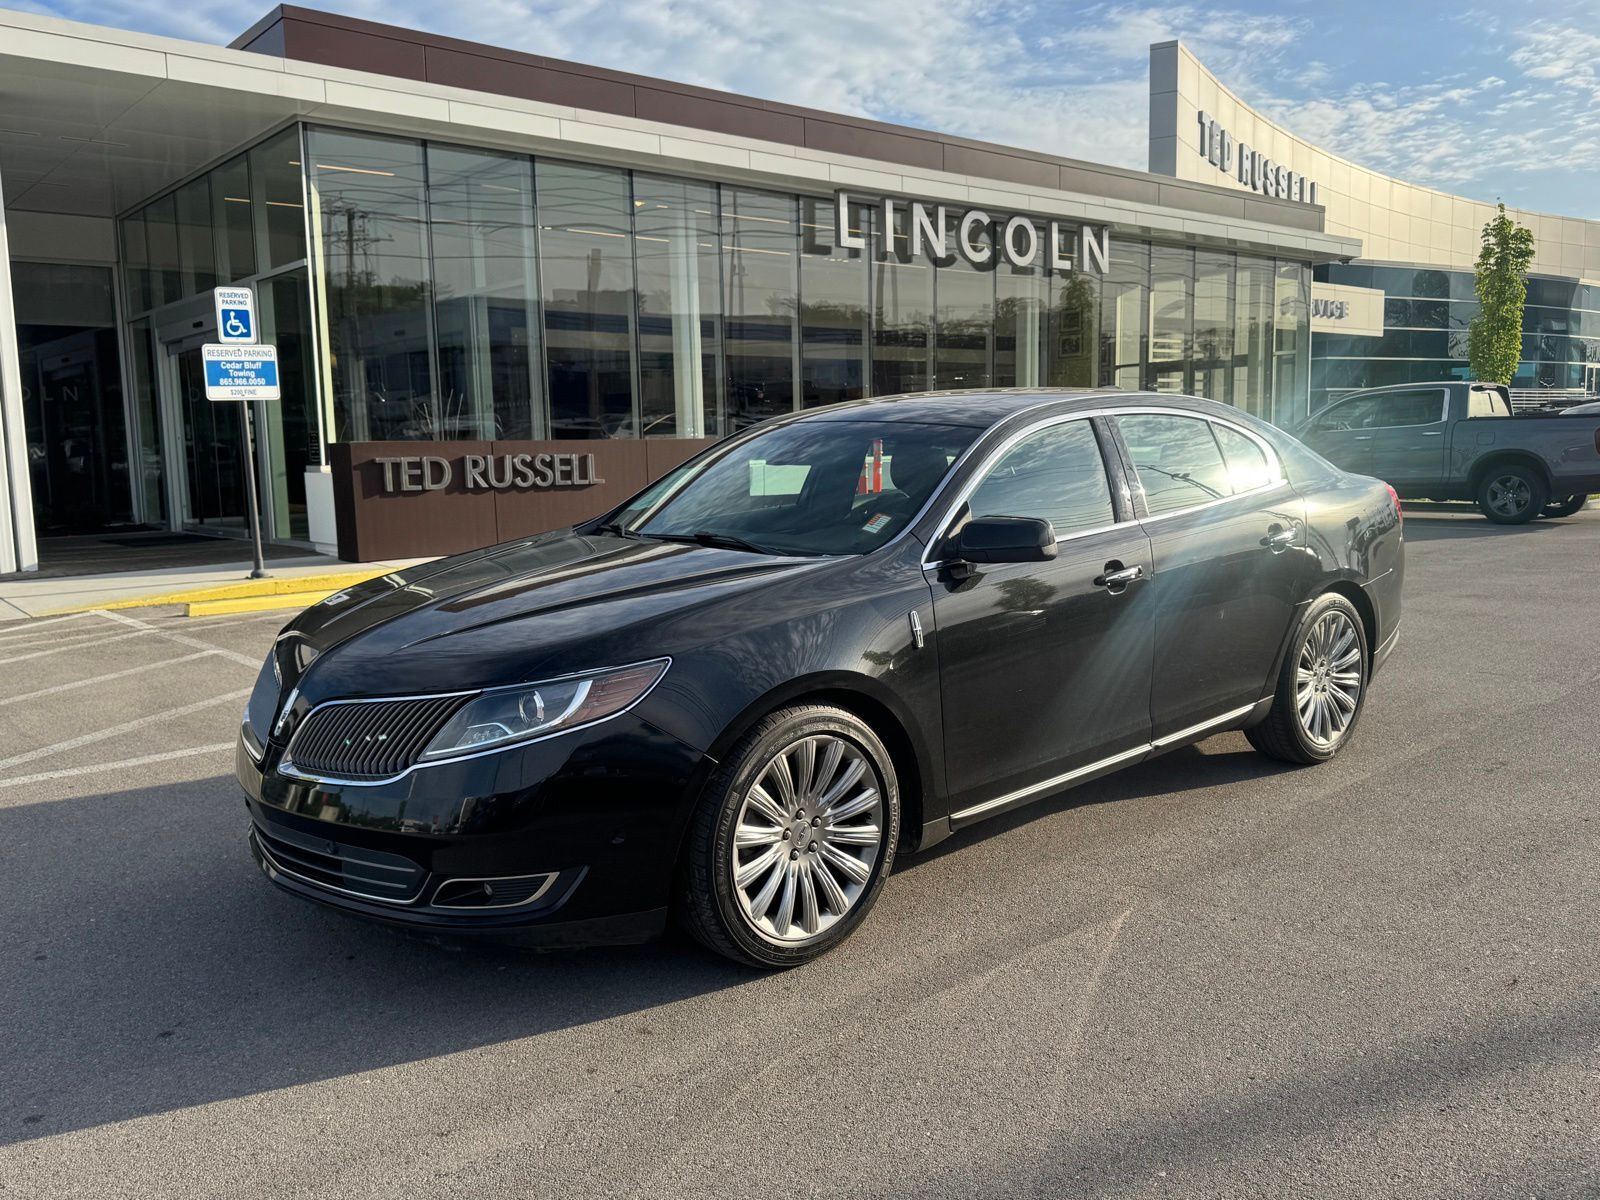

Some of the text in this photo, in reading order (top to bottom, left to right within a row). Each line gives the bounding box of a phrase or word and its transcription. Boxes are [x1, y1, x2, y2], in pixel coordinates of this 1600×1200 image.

[1198, 110, 1318, 204] TED RUSSELL
[835, 189, 1110, 275] LINCOLN
[207, 349, 273, 358] RESERVED PARKING
[229, 369, 255, 378] Towing
[375, 453, 606, 492] TED RUSSELL
